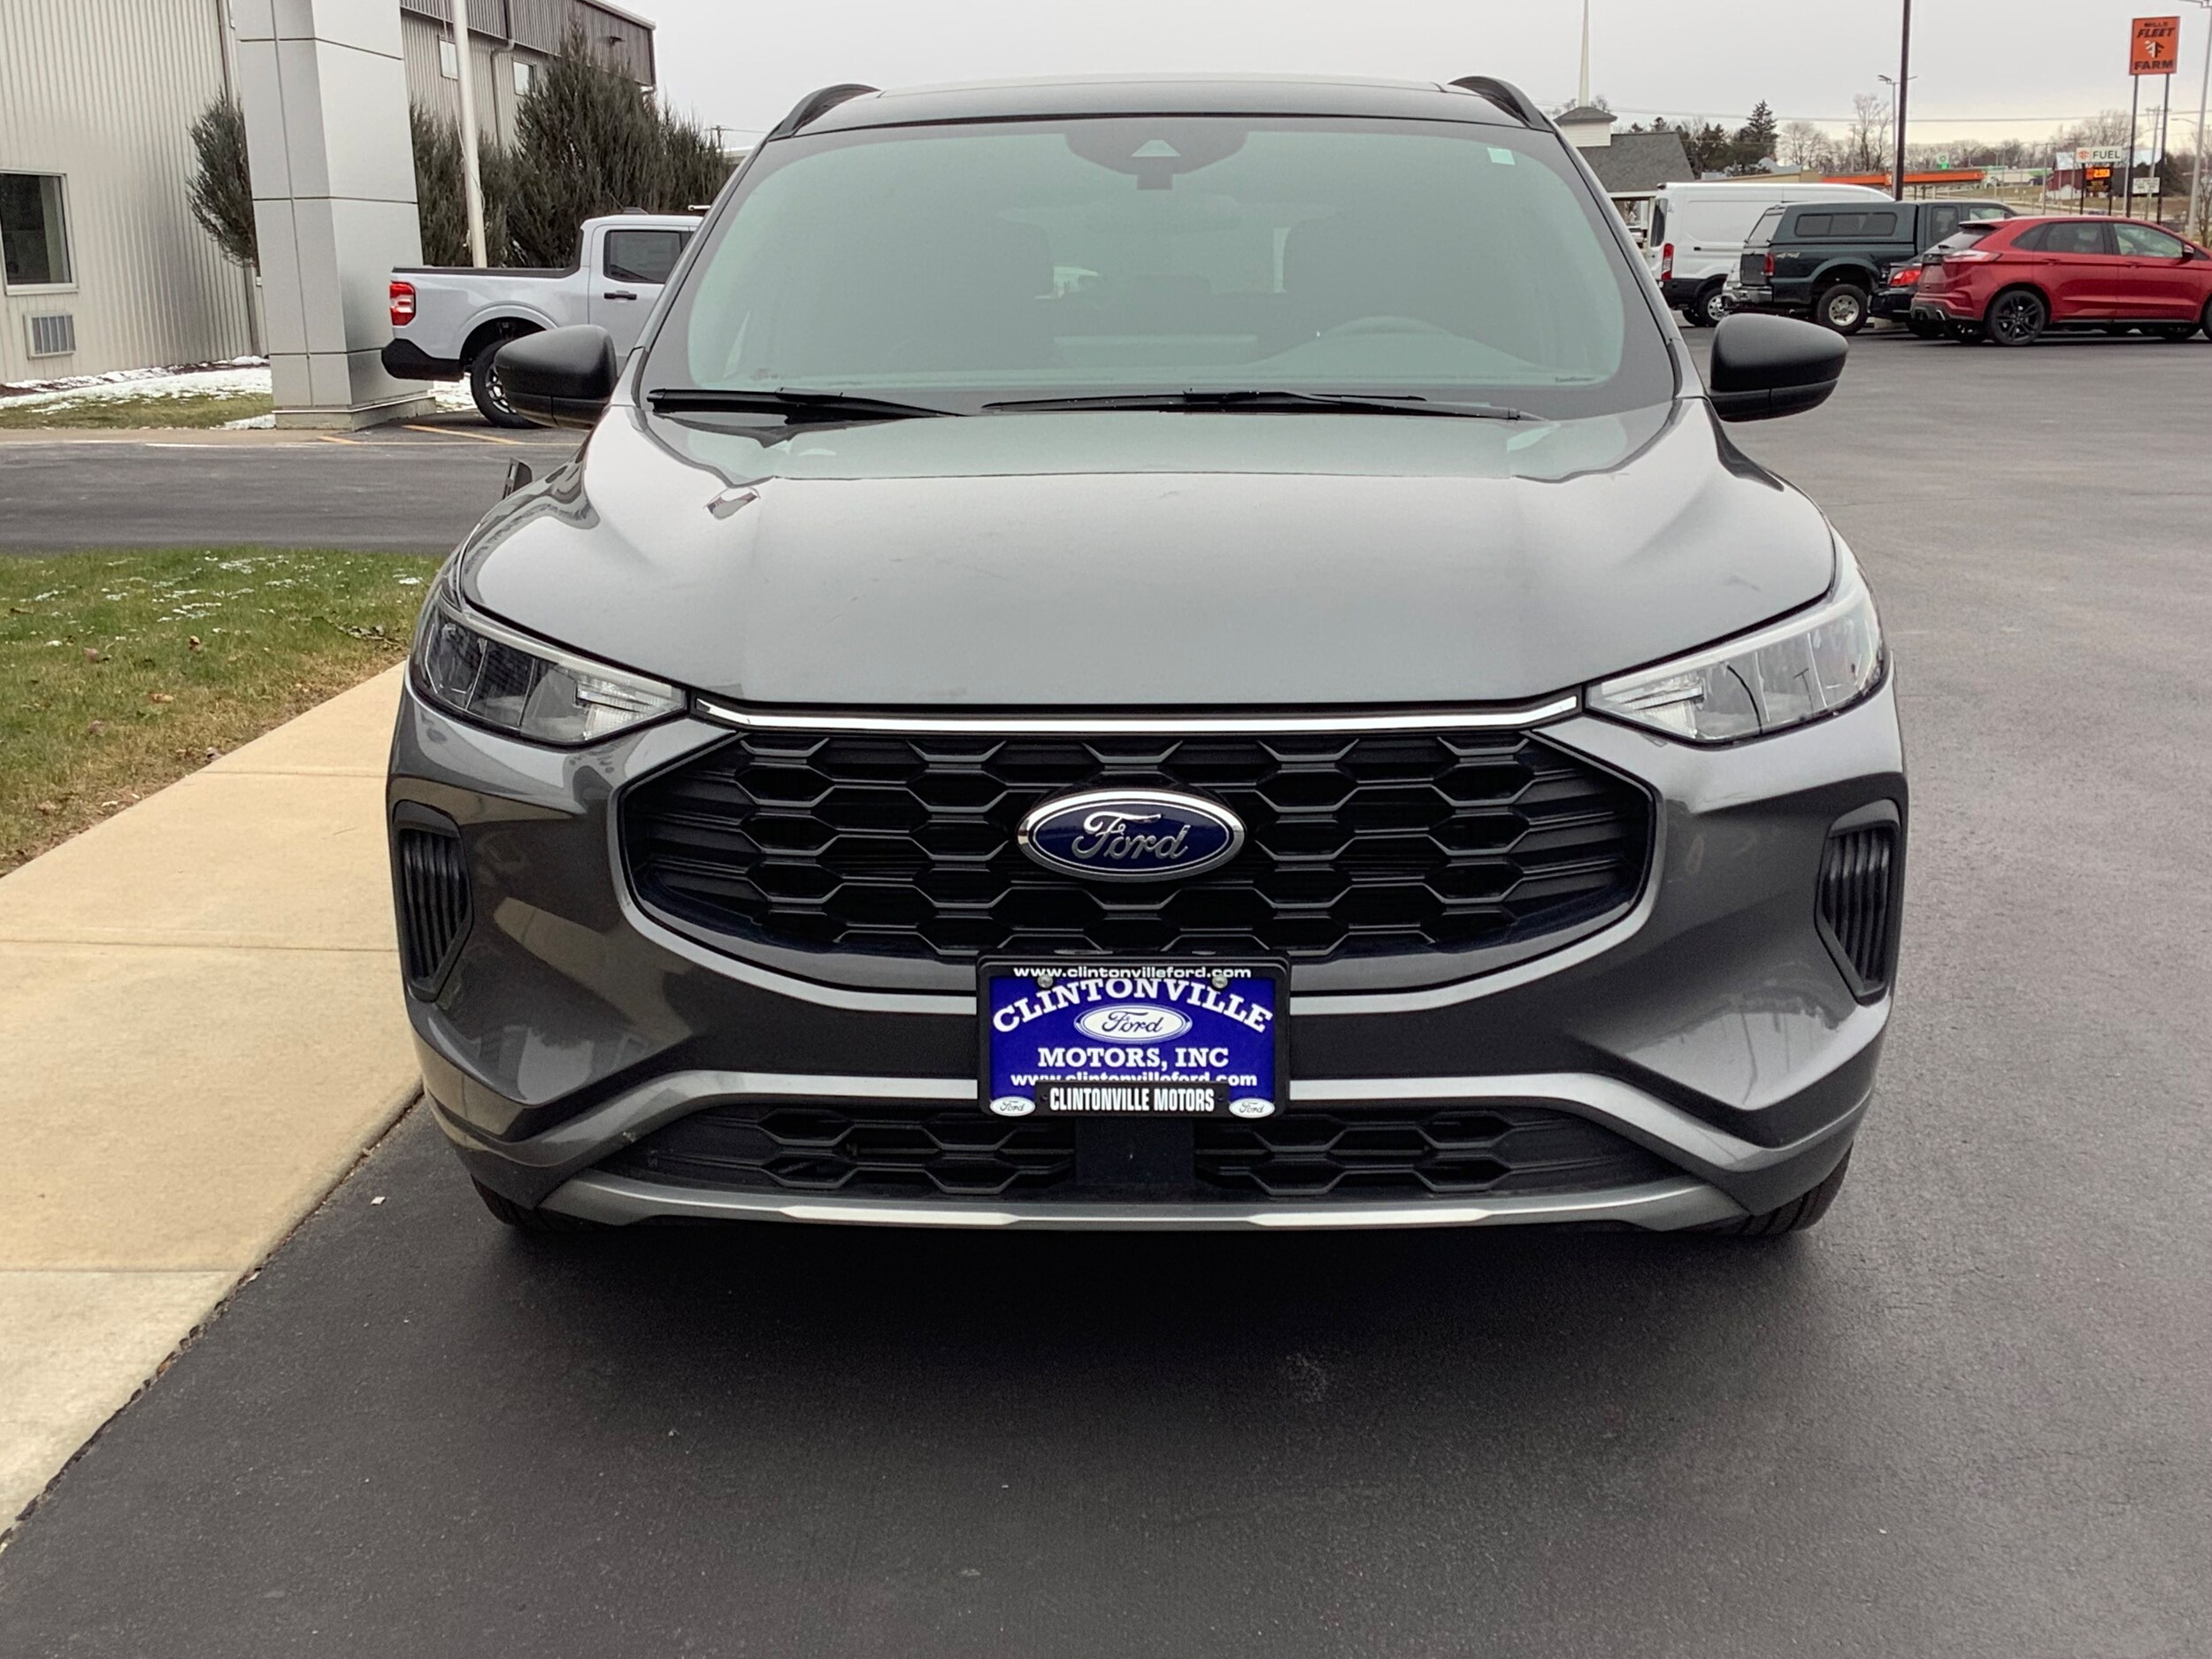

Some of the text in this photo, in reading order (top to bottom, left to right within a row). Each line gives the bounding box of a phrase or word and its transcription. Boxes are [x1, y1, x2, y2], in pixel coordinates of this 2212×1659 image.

[2137, 27, 2176, 38] FLEET
[2134, 60, 2174, 70] FARM
[2093, 150, 2120, 159] FUEL
[1071, 811, 1191, 859] Ford
[1013, 966, 1252, 979] www.clintonvilleford.com
[993, 977, 1272, 1033] CLINTONVILLE
[1102, 1010, 1164, 1033] Ford
[1038, 1047, 1229, 1071] MOTORS, INC
[1000, 1100, 1025, 1112] Ford
[1049, 1087, 1215, 1112] CLINTONVILLE MOTORS
[1239, 1102, 1264, 1114] Ford
